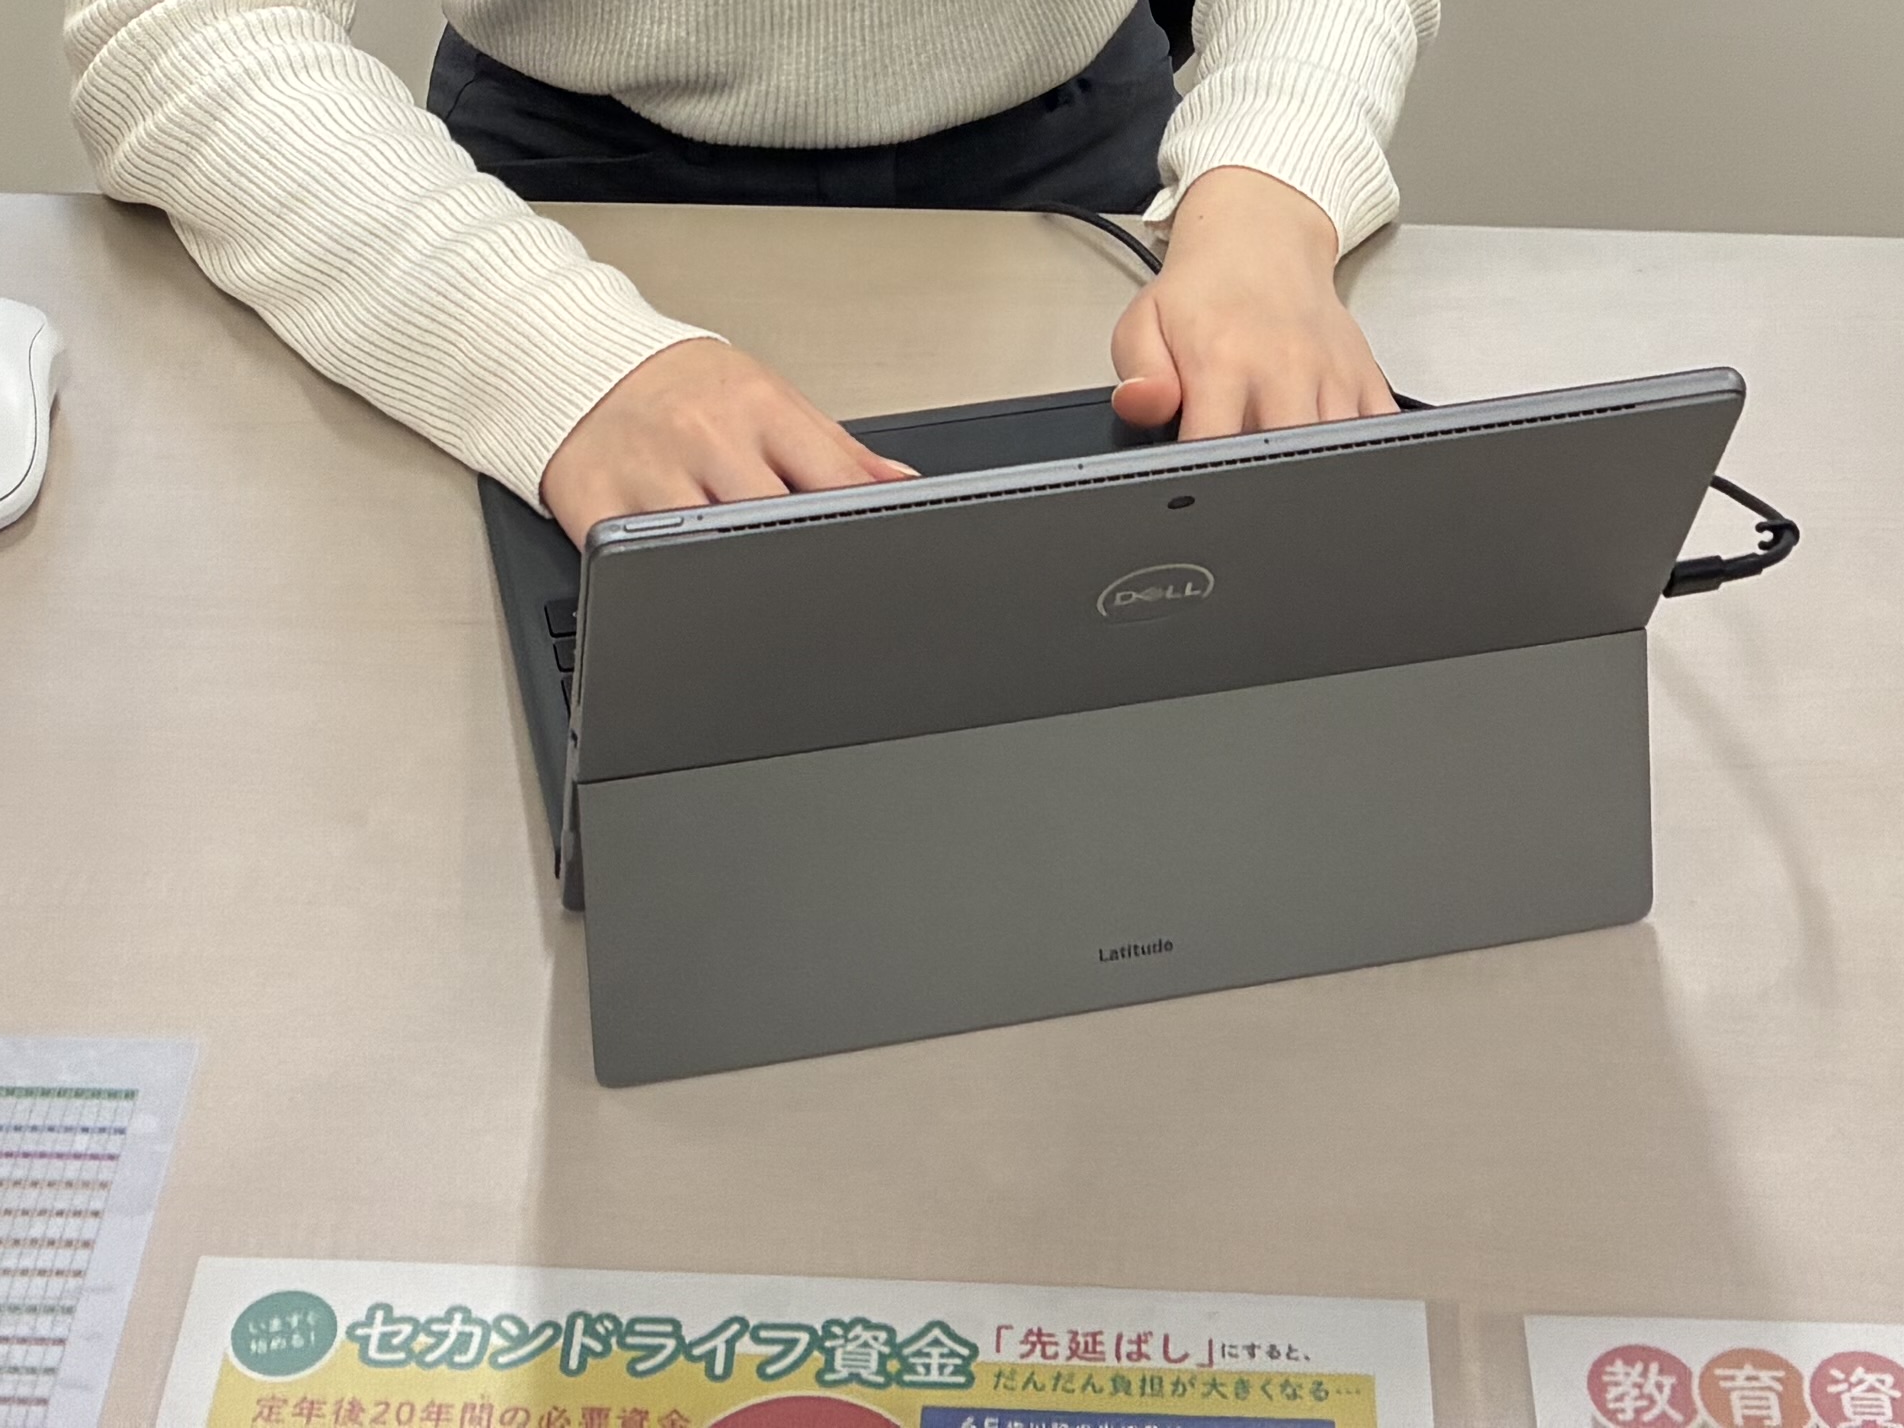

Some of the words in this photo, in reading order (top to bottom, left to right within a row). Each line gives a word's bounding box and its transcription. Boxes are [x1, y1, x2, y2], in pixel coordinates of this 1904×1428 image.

[1098, 938, 1174, 963] Latitude
[347, 1302, 978, 1388] セカンドライフ資金
